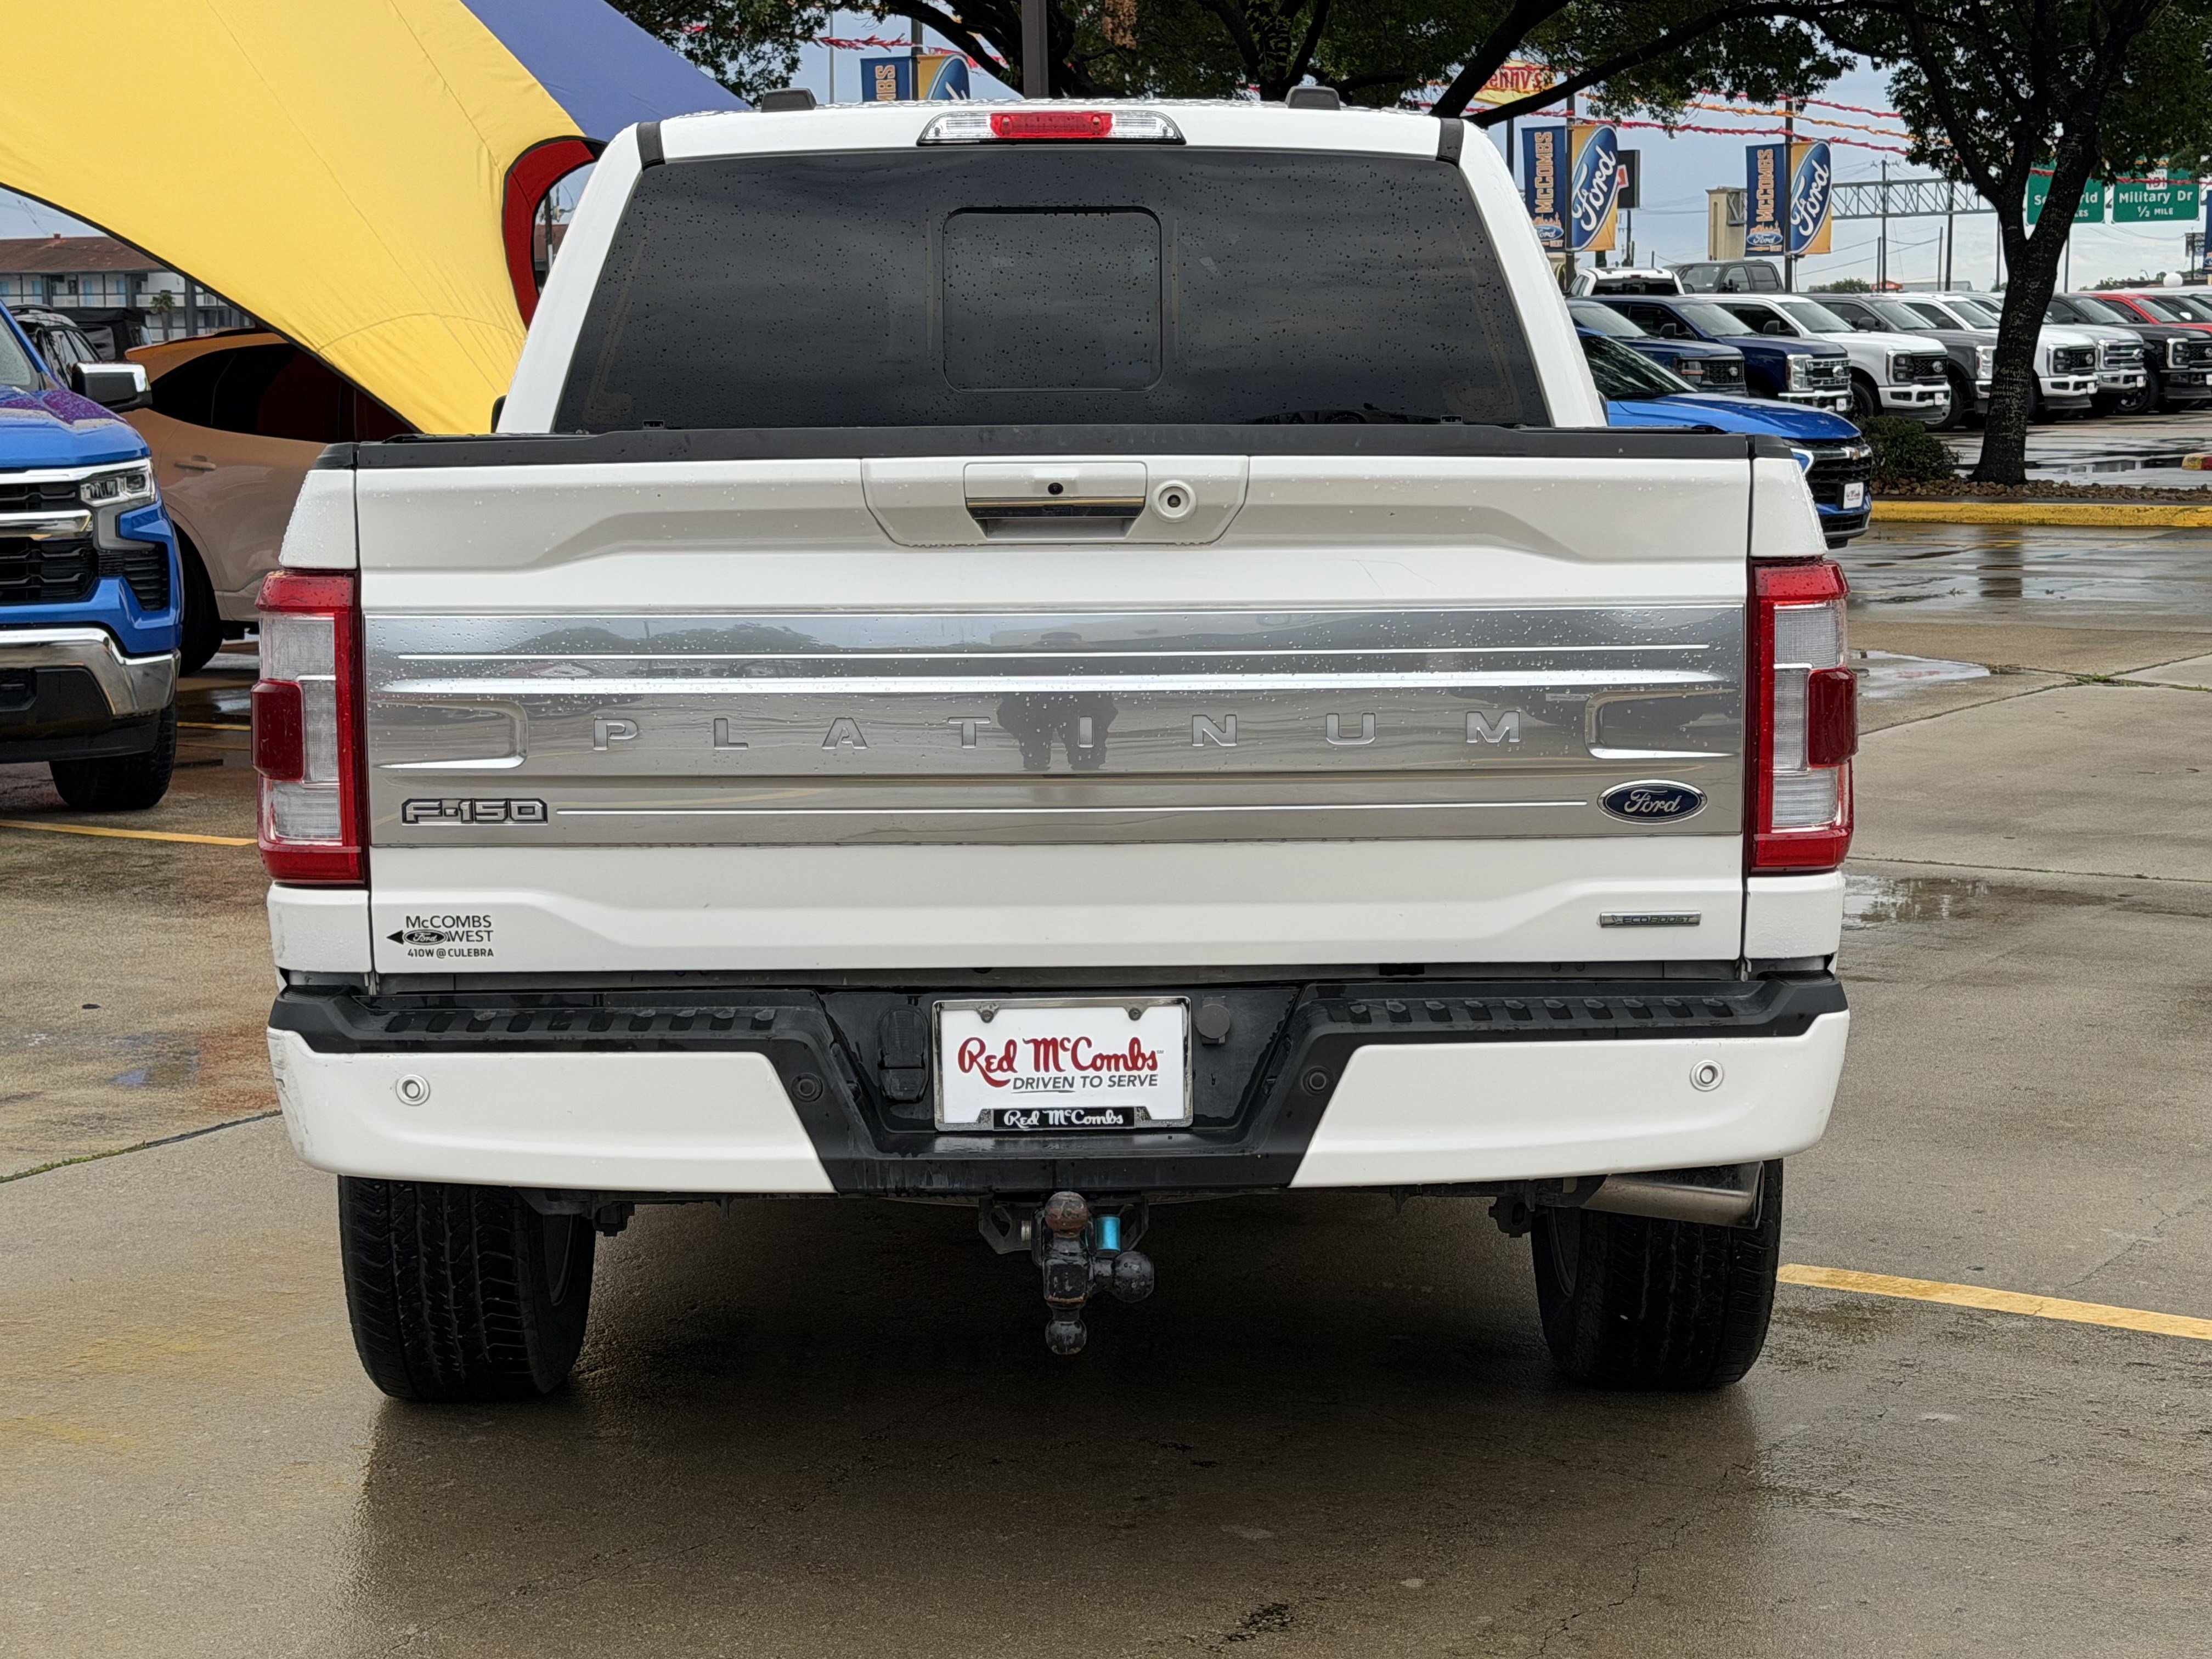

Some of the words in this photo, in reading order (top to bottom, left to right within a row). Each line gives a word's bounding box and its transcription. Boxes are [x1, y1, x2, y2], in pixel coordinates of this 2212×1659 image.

[1489, 70, 1542, 89] enny's
[1572, 145, 1616, 231] Ford
[1791, 159, 1829, 236] Ford
[2119, 191, 2171, 205] Military
[2177, 190, 2193, 201] Dr
[2154, 207, 2174, 216] MILE
[593, 711, 1521, 751] PLATINUM
[402, 798, 548, 824] F-150
[1624, 789, 1683, 813] Ford
[405, 915, 492, 929] McCOMBS
[448, 930, 494, 942] WEST
[958, 1037, 1018, 1088] Red
[1022, 1036, 1158, 1073] McCombs
[1013, 1076, 1075, 1090] DRIVEN
[1080, 1075, 1103, 1088] TO
[1107, 1073, 1158, 1087] SERVE
[1003, 1110, 1040, 1130] Red
[1042, 1109, 1124, 1125] McCombs
